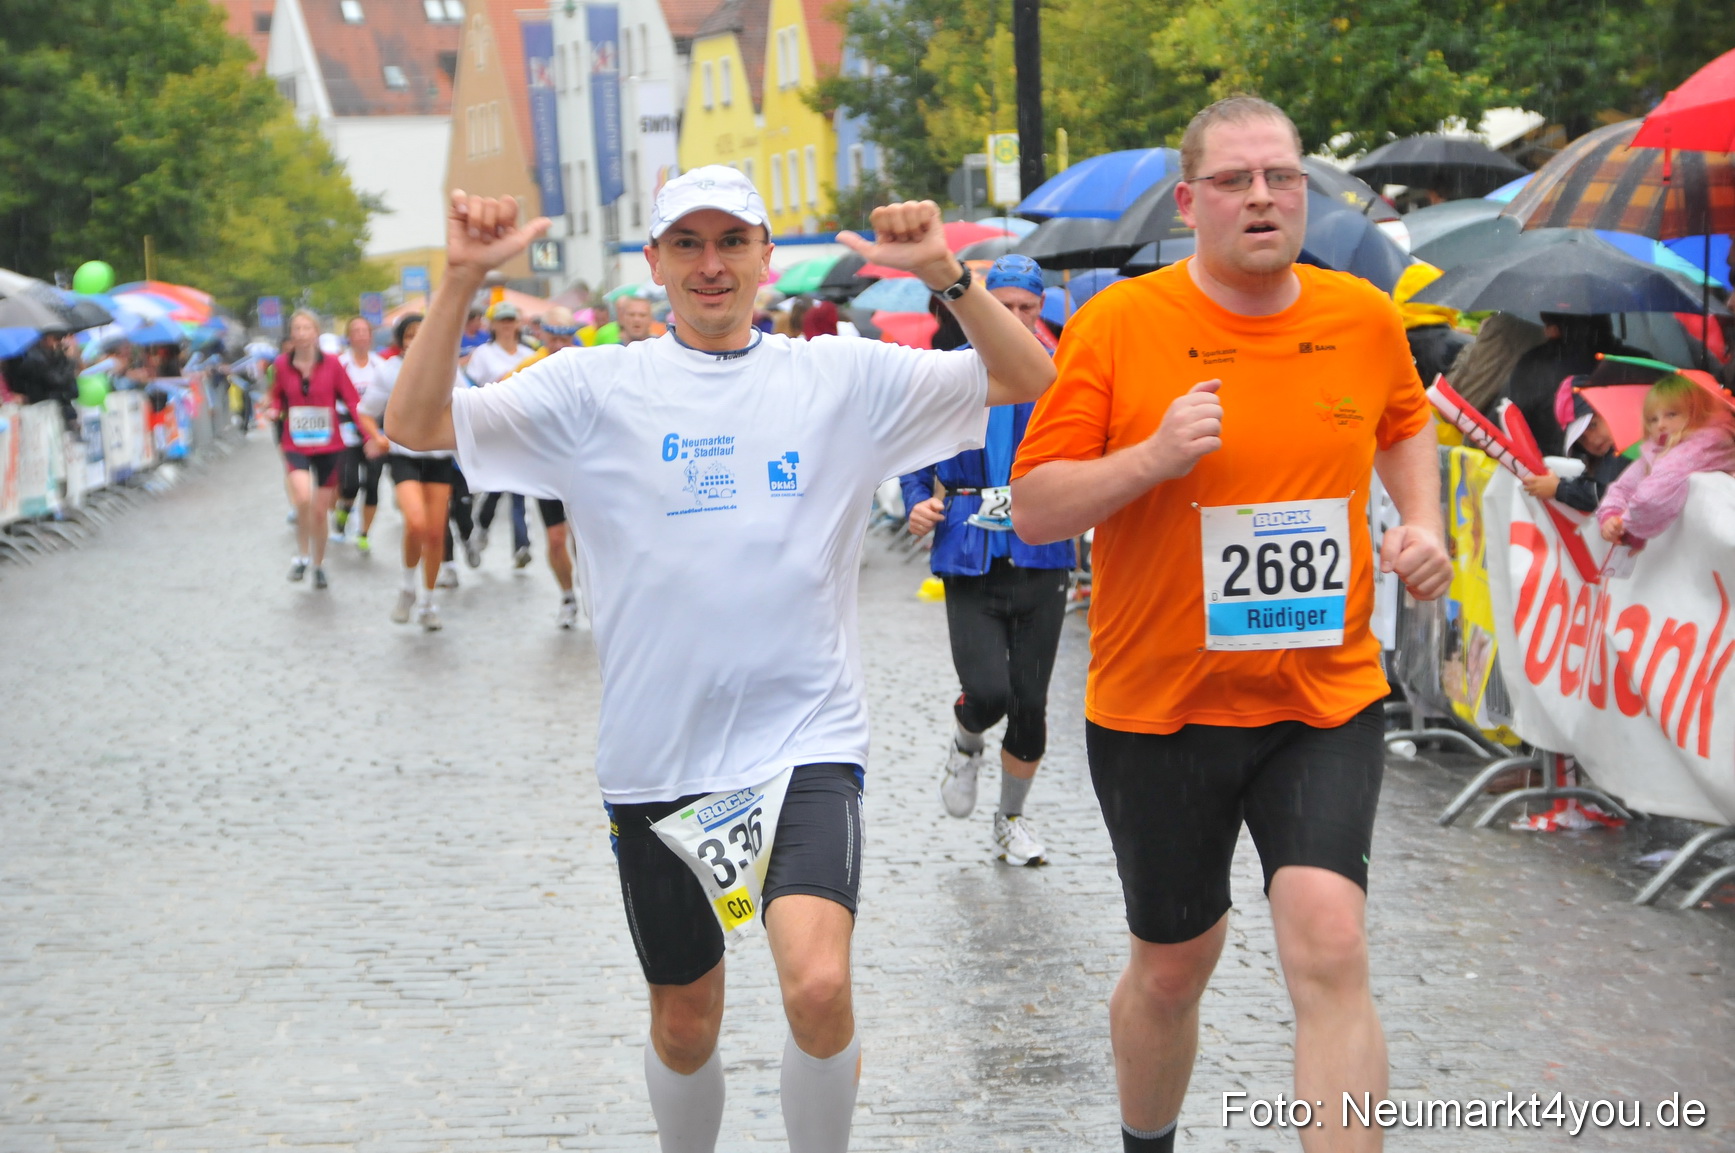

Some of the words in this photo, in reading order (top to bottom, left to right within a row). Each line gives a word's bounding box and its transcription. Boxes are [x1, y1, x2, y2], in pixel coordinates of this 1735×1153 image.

[662, 432, 688, 462] 6.
[681, 435, 735, 449] Neumarkter
[693, 445, 735, 458] Stadtlauf
[771, 480, 796, 490] DKMS
[666, 505, 737, 516] www.stadtlauf-neumarkt.de
[1252, 509, 1312, 528] BOCK
[1222, 538, 1344, 597] 2682
[1246, 606, 1328, 631] Rüdiger
[696, 786, 757, 825] BOCK
